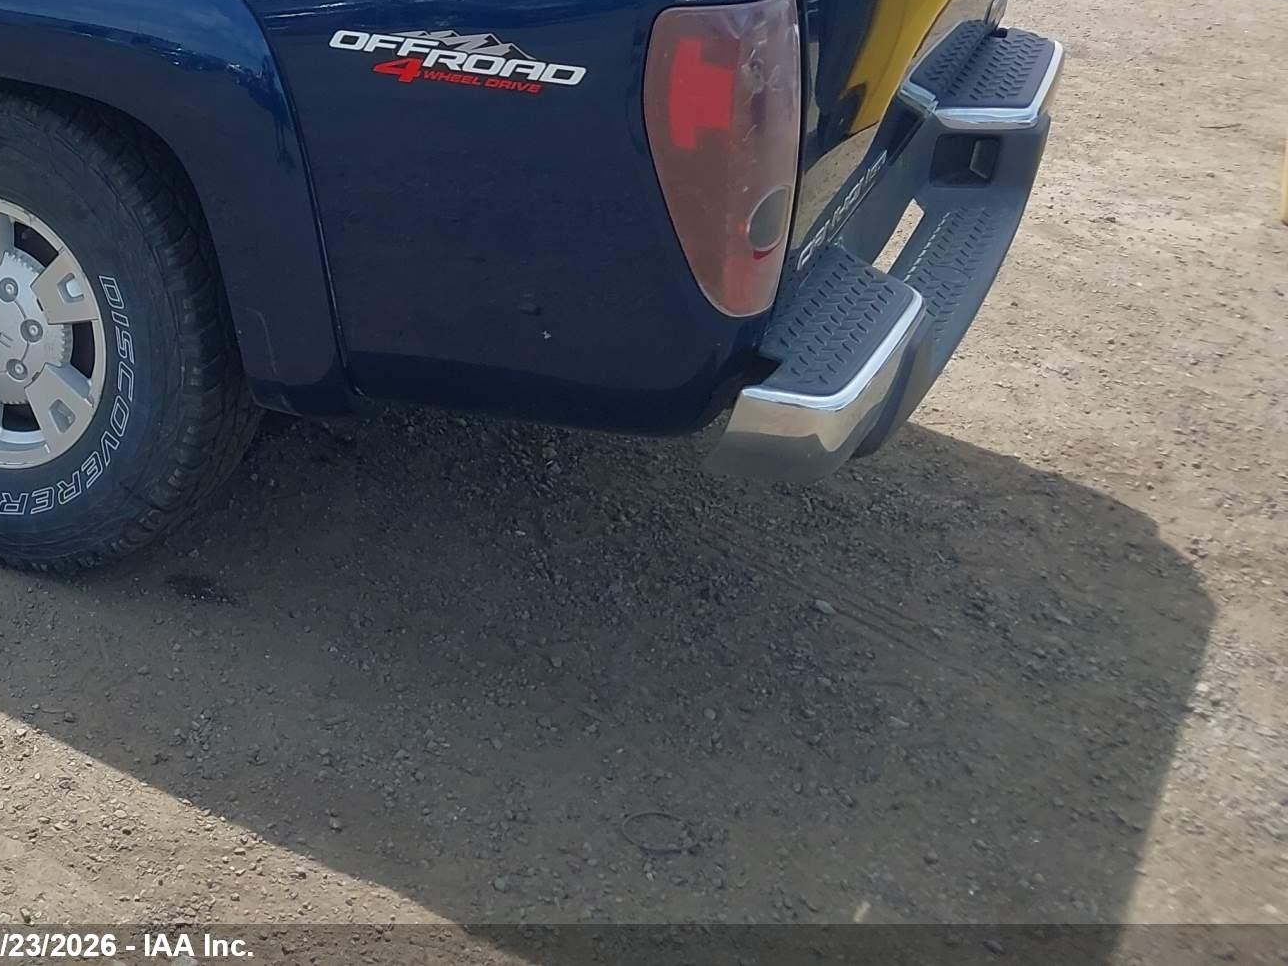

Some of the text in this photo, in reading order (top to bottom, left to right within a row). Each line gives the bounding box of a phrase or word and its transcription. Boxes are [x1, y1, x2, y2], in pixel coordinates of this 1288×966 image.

[372, 57, 543, 94] 4 WHEEL DRIVE
